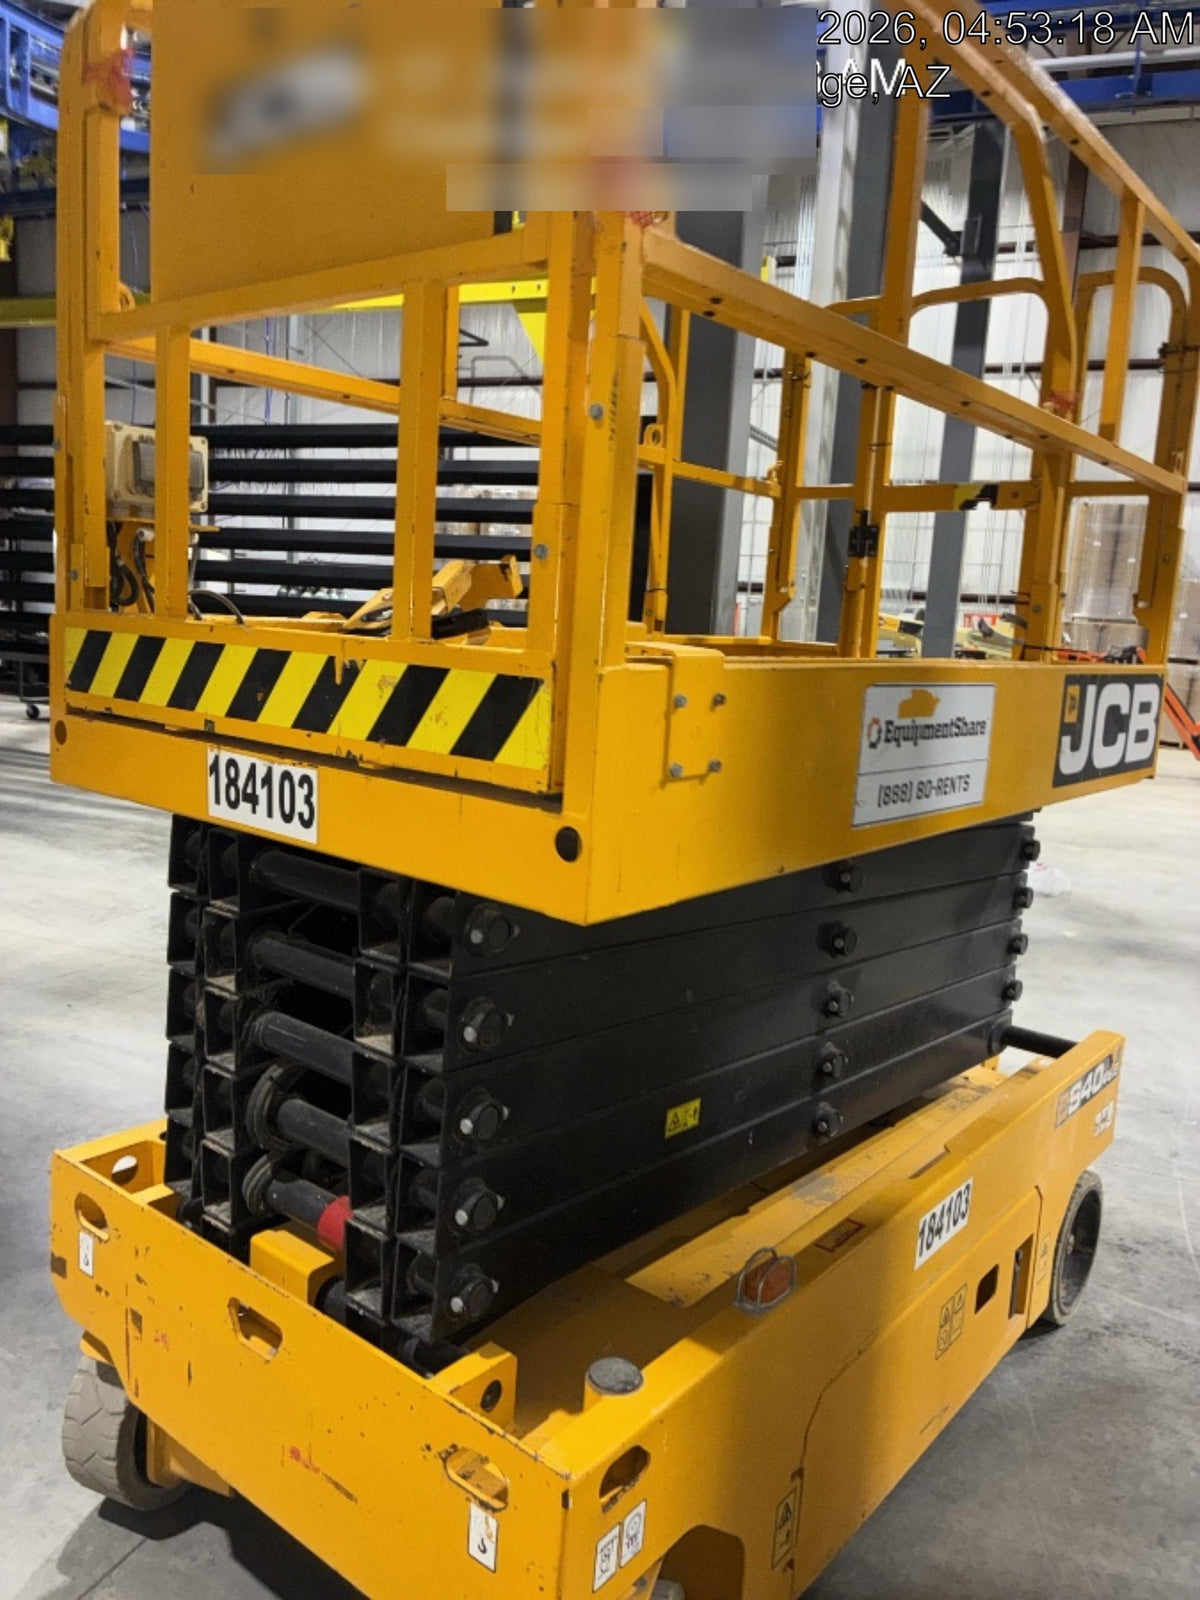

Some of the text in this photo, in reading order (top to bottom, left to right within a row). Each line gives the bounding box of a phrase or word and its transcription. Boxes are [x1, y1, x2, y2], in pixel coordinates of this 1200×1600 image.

[884, 716, 987, 747] EquipmentShare
[1059, 683, 1160, 775] JCB
[209, 754, 315, 829] 184103
[919, 1183, 970, 1258] 184103
